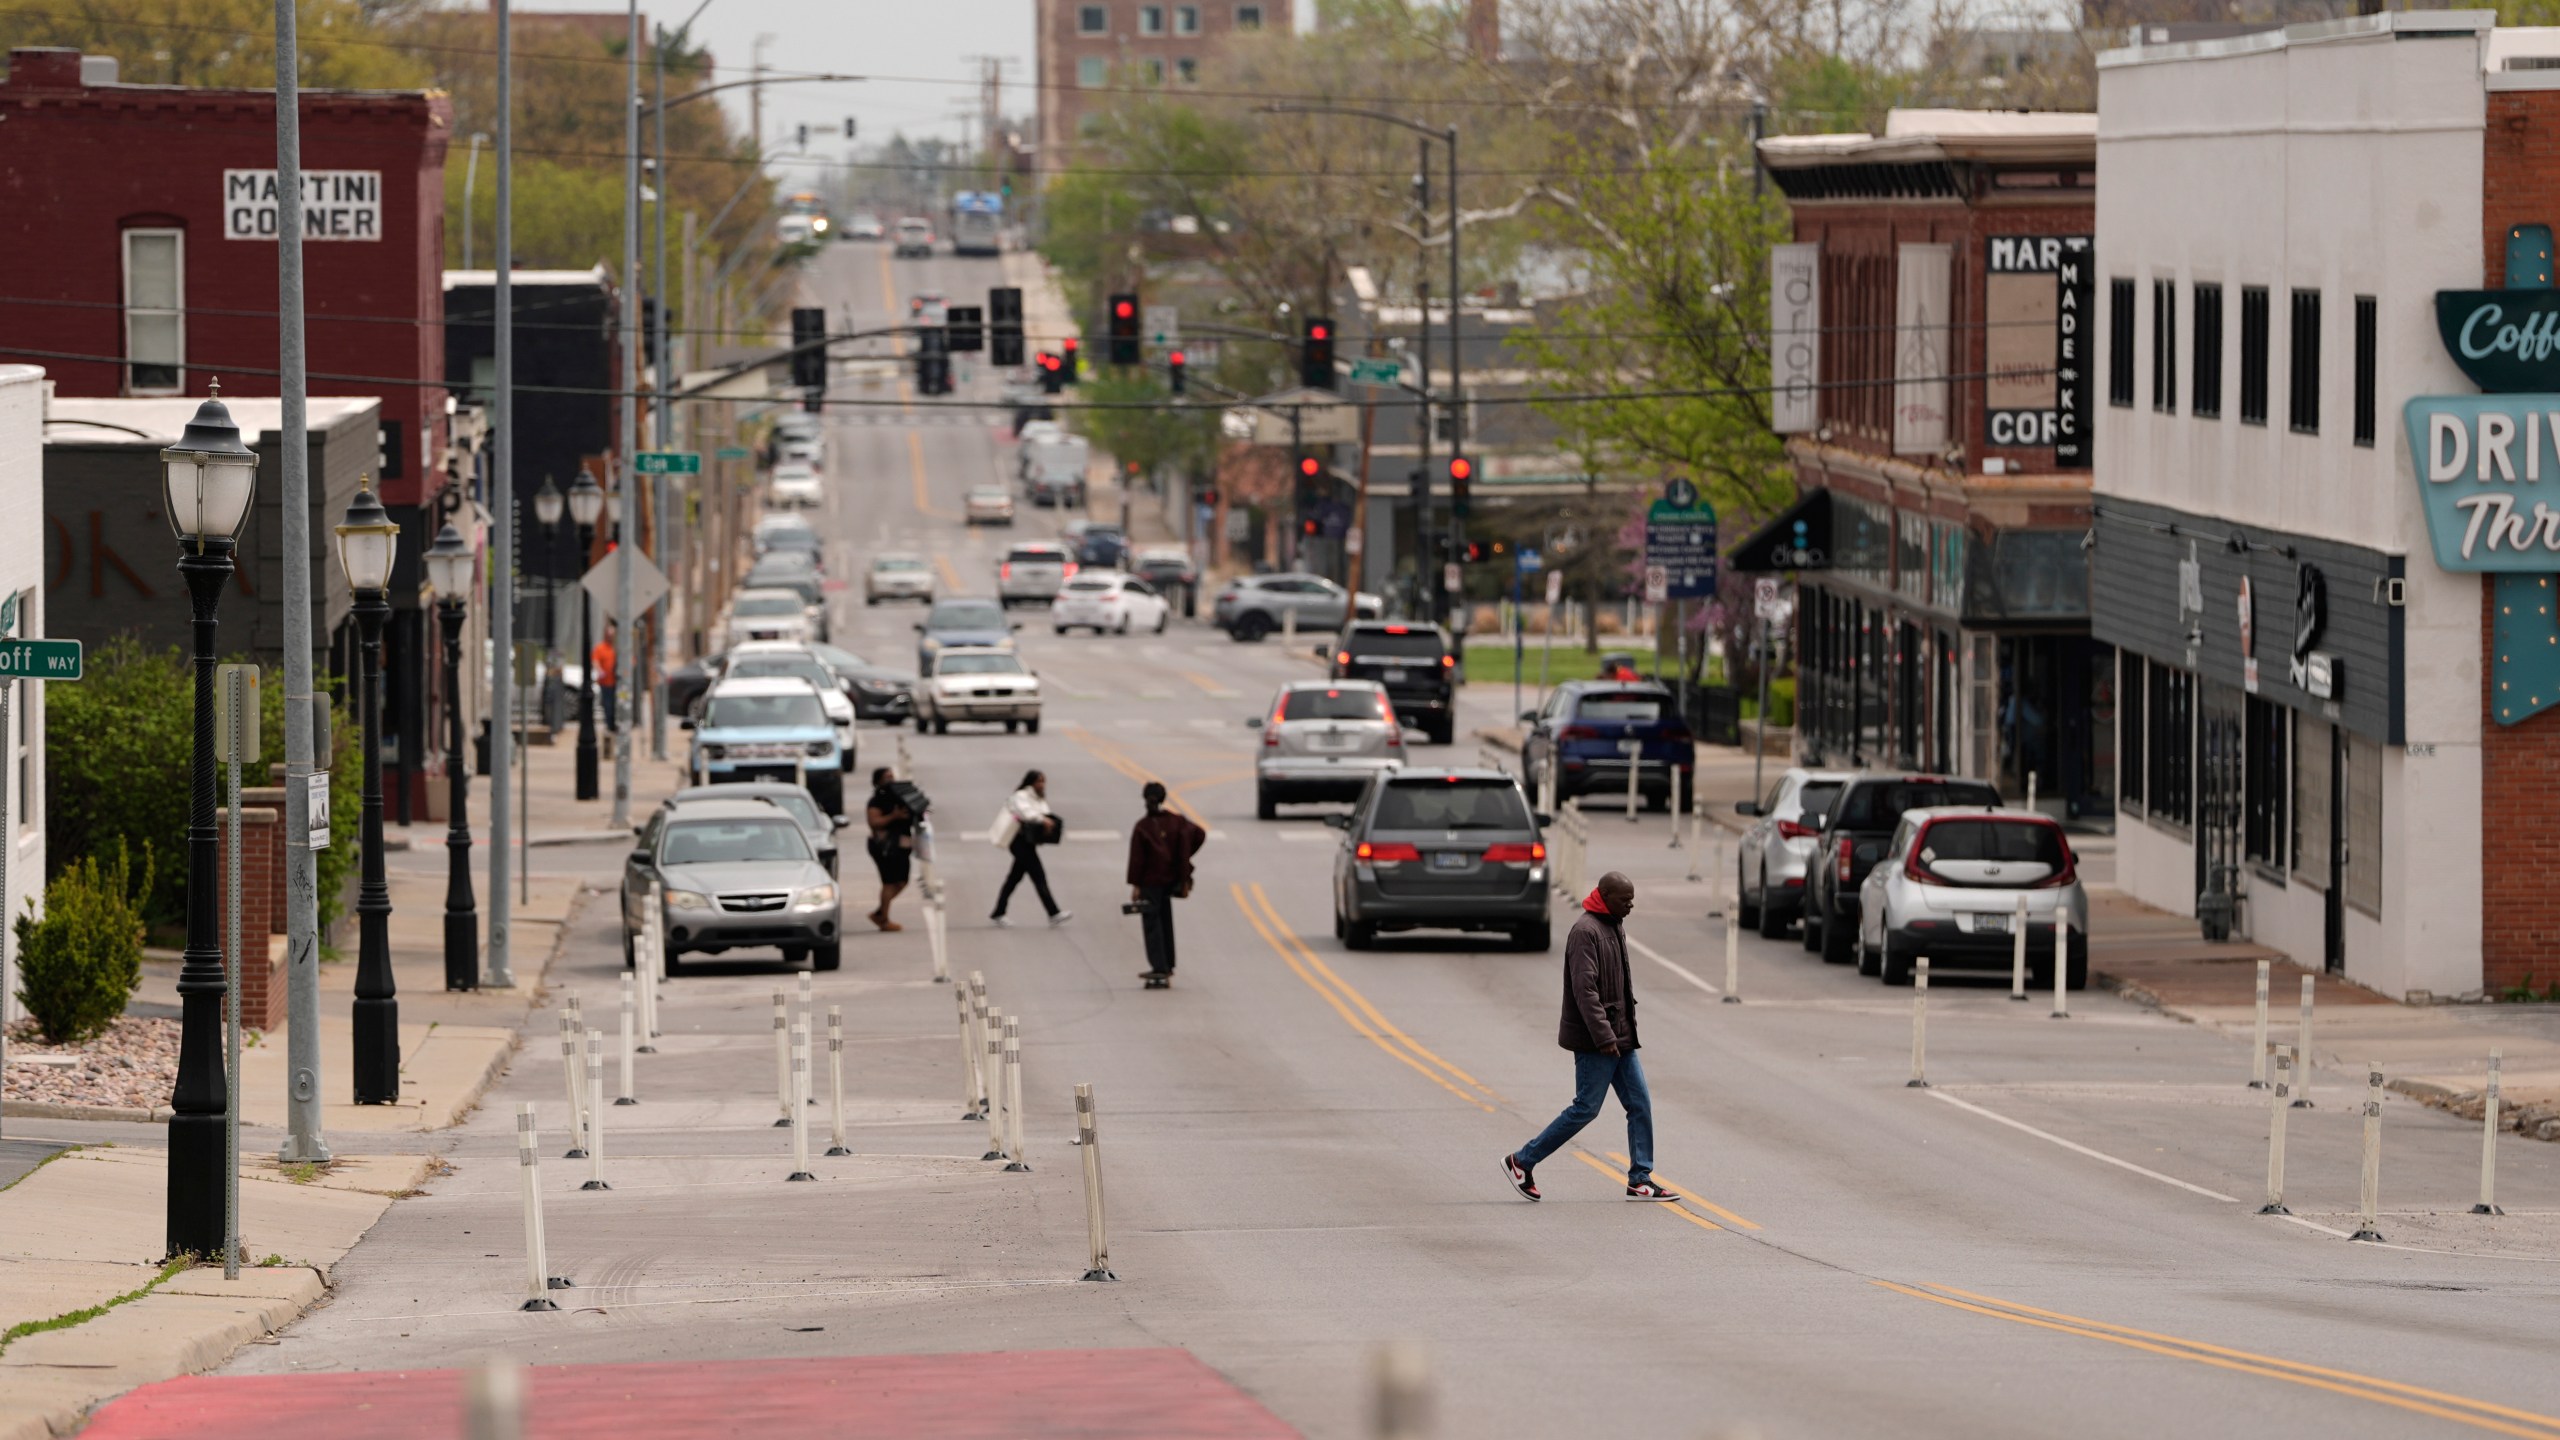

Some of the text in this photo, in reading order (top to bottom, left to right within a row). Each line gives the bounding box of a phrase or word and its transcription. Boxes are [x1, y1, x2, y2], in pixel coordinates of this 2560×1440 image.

[229, 174, 375, 202] MATINI
[232, 207, 374, 236] CONER
[2061, 262, 2078, 359] MADE
[2459, 303, 2560, 362] Coff
[47, 656, 76, 670] WAY
